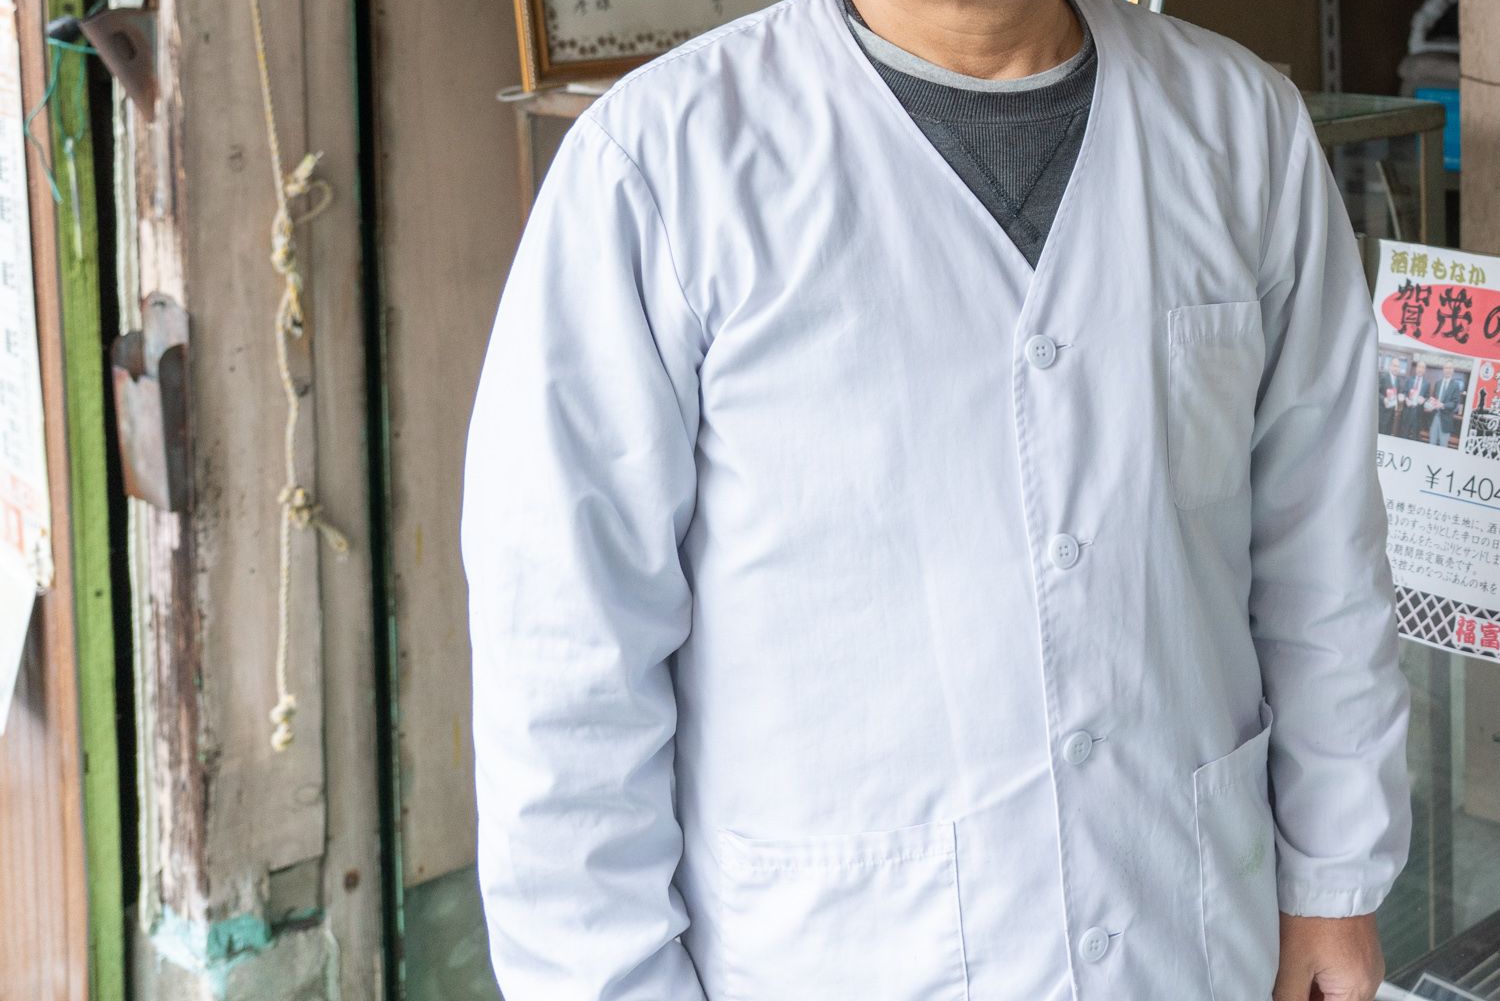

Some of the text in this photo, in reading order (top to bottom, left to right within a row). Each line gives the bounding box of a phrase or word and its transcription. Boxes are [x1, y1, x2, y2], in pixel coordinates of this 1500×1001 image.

[1390, 250, 1486, 285] 酒樽もなか
